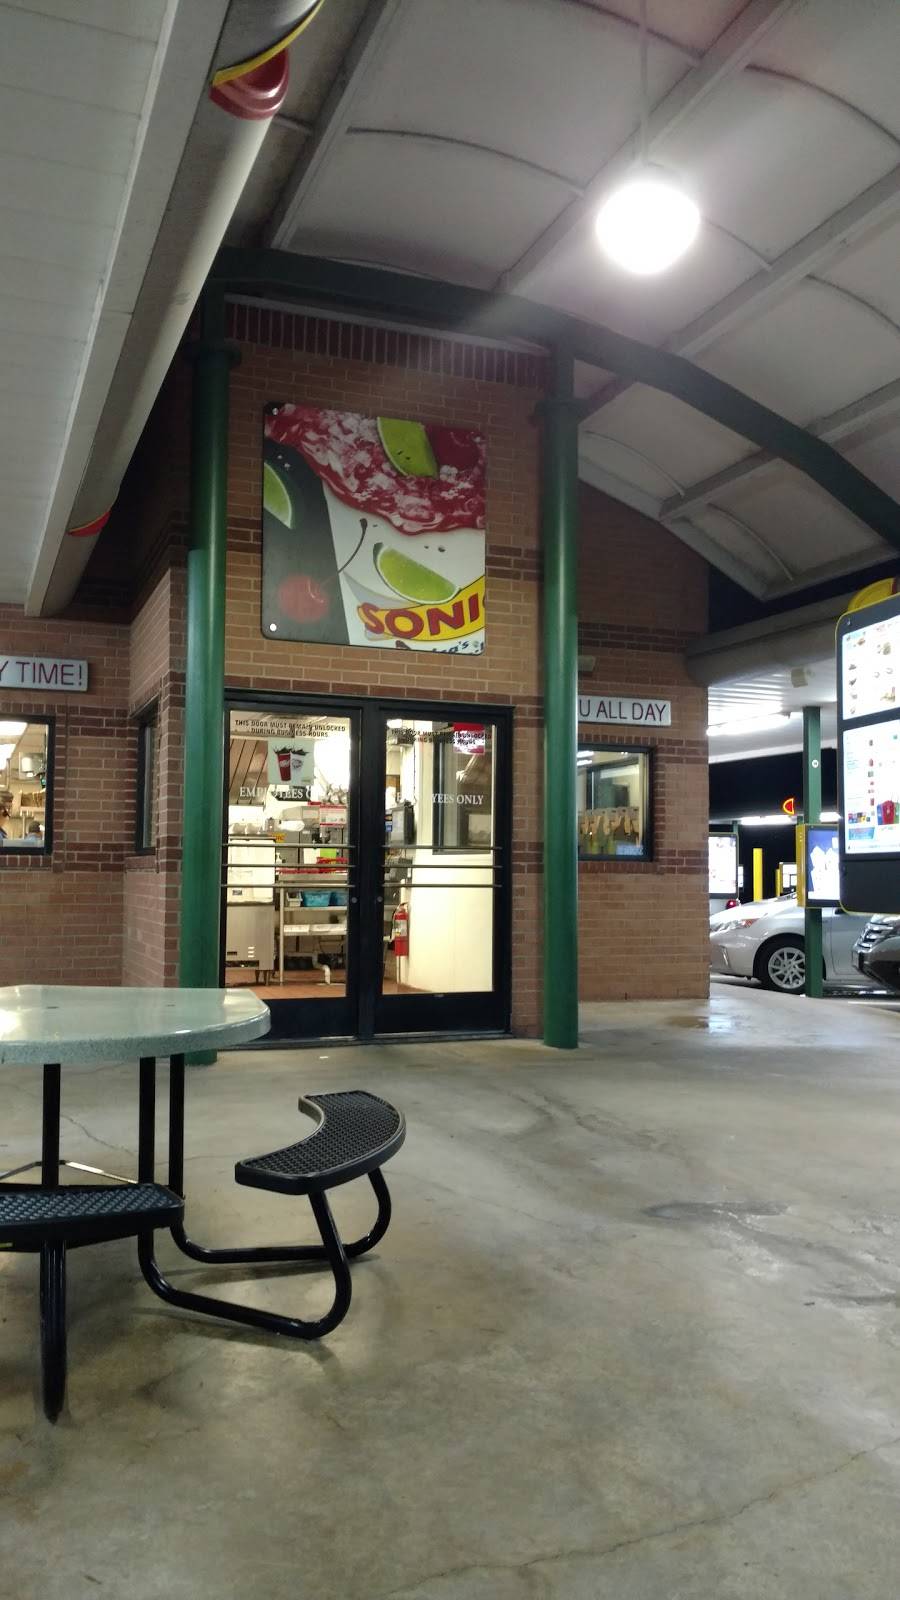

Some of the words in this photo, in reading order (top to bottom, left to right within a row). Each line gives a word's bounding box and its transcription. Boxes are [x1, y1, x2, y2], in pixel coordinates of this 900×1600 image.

[360, 592, 485, 640] SONI
[16, 661, 82, 686] TIME!
[596, 700, 628, 720] ALL
[632, 702, 667, 722] DAY
[235, 719, 249, 727] THIS
[289, 722, 312, 730] REMAIN
[314, 724, 346, 732] UNLOCKED
[308, 730, 329, 738] HOURS
[456, 794, 484, 805] ONLY
